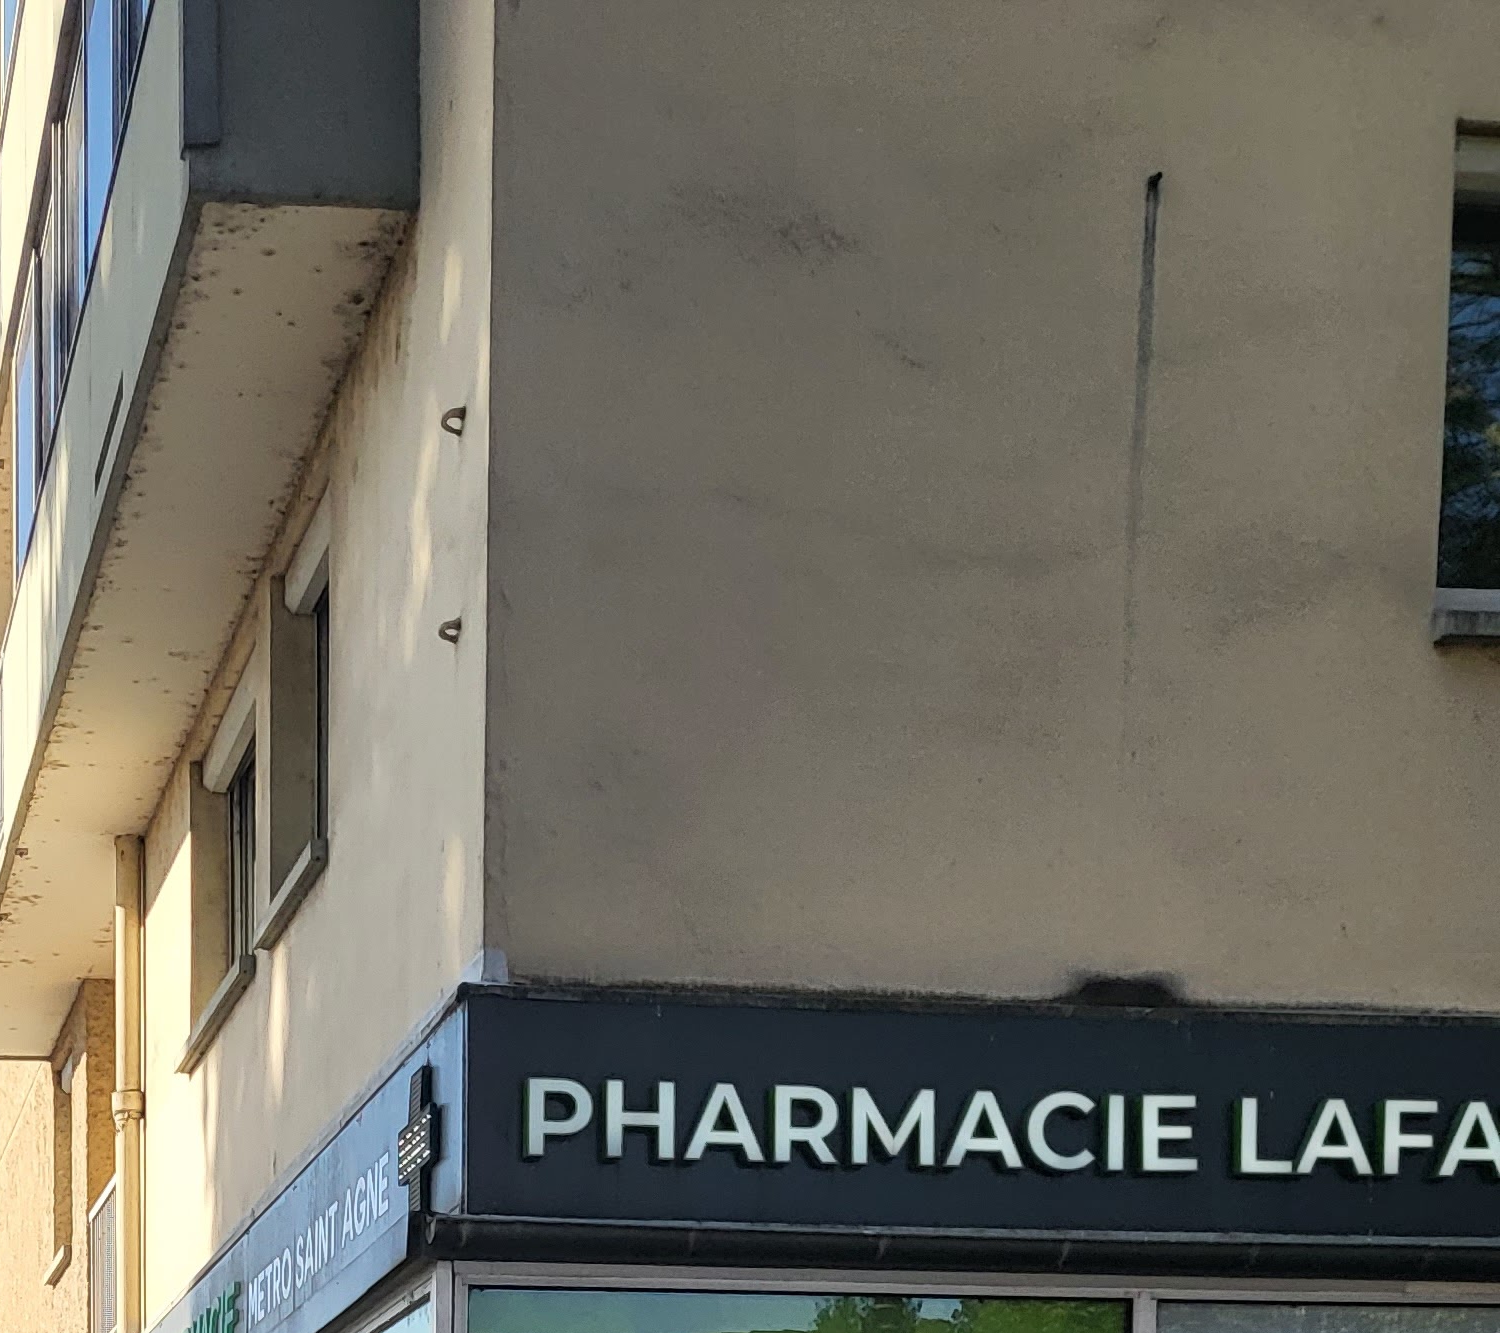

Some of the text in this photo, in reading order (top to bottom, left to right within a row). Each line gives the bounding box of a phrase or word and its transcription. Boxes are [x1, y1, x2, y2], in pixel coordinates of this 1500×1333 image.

[522, 1075, 1198, 1172] PHARMACIE
[249, 1247, 292, 1328] METRO
[295, 1200, 339, 1290] SAINT
[341, 1151, 390, 1249] AGNE
